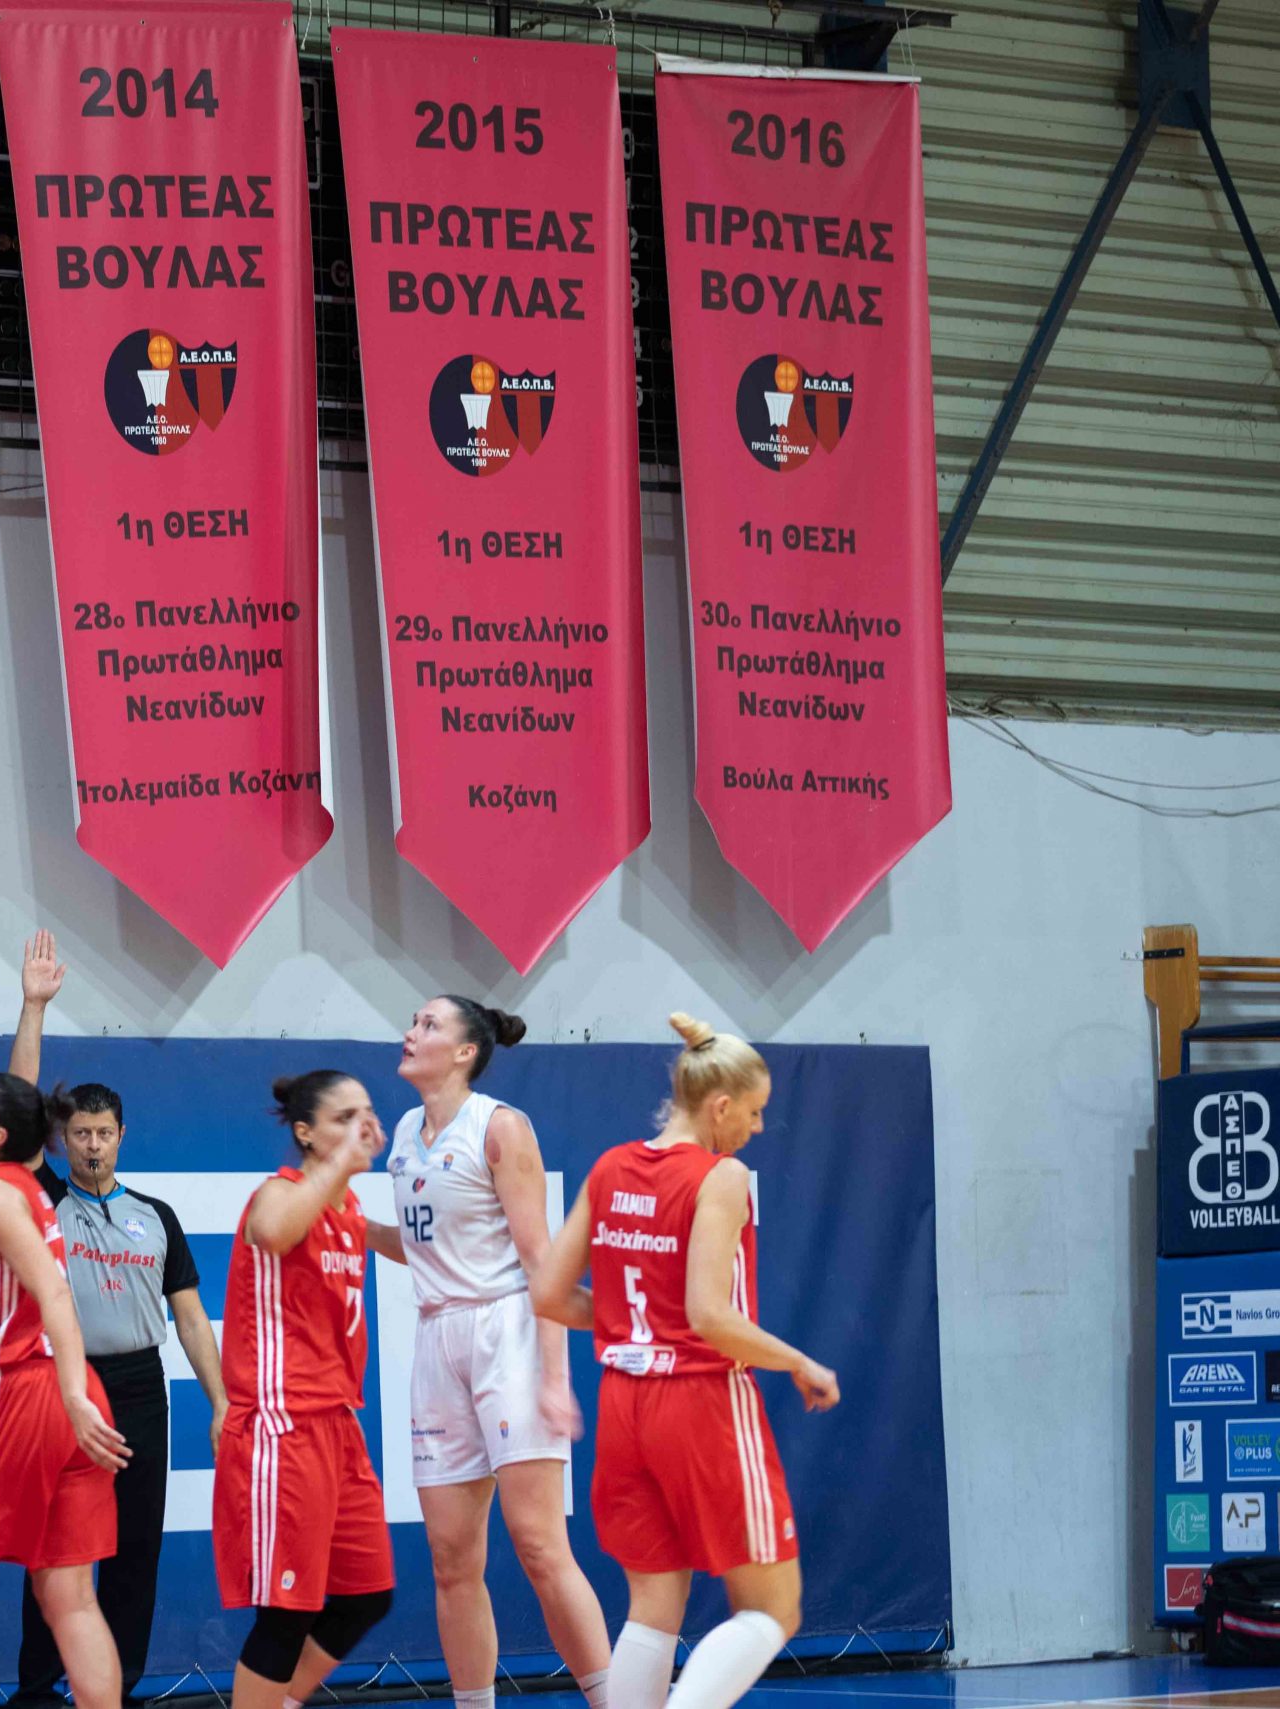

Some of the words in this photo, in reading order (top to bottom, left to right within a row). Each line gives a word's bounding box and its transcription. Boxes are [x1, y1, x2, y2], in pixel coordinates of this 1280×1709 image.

[79, 67, 219, 119] 2014
[414, 101, 544, 155] 2015
[727, 110, 846, 168] 2016
[34, 174, 275, 219] ΠΡΩΤΕΑΣ
[369, 201, 595, 254] ΠΡΩΤΕΑΣ
[685, 201, 894, 262] ΠΡΩΤΕΑΣ
[56, 245, 266, 290] ΒΟΥΛΑΣ
[387, 271, 585, 321] ΒΟΥΛΑΣ
[701, 269, 883, 327] ΒΟΥΛΑΣ
[180, 351, 236, 363] Α.Ε.Ο.Π.Β.
[501, 378, 554, 391] Α.Ε.Ο.Π.Β.
[804, 378, 852, 392] Α.Ε.Ο.Π.Β.
[125, 425, 160, 435] ΠΡΩΤΕΑΣ
[162, 425, 190, 434] ΒΟΥΛΑΣ
[151, 436, 167, 445] 1980
[446, 447, 480, 457] ΠΡΩΤΕΑΣ
[482, 448, 510, 458] ΒΟΥΛΑΣ
[752, 441, 781, 453] ΠΡΩΤΕΑΣ
[783, 445, 809, 455] ΒΟΥΛΑΣ
[117, 512, 154, 547] 1η
[164, 509, 249, 539] ΘΕΣΗ
[738, 521, 772, 555] 1η
[782, 524, 856, 554] ΘΕΣΗ
[436, 530, 471, 564] 1η
[481, 530, 563, 559] ΘΕΣΗ
[135, 596, 300, 636] Πανελλήνιο
[452, 613, 609, 648] Πανελλήνιο
[750, 604, 901, 642] Πανελλήνιο
[97, 644, 283, 682] Πρωτάθλημα
[416, 659, 594, 694] Πρωτάθλημα
[716, 646, 885, 684] Πρωτάθλημα
[126, 691, 265, 722] Νεανίδων
[442, 706, 576, 735] Νεανίδων
[738, 691, 866, 722] Νεανίδων
[229, 769, 321, 799] Κοζάνη
[467, 783, 558, 815] Κοζάνη
[723, 765, 794, 792] Βούλα
[801, 769, 890, 801] Αττικής
[404, 1205, 433, 1242] 42
[1190, 1205, 1280, 1229] VOLLEYBALL
[624, 1265, 654, 1344] 5
[1236, 1308, 1263, 1320] Navios
[1181, 1363, 1245, 1385] ARENA
[1245, 1446, 1272, 1460] PLUS
